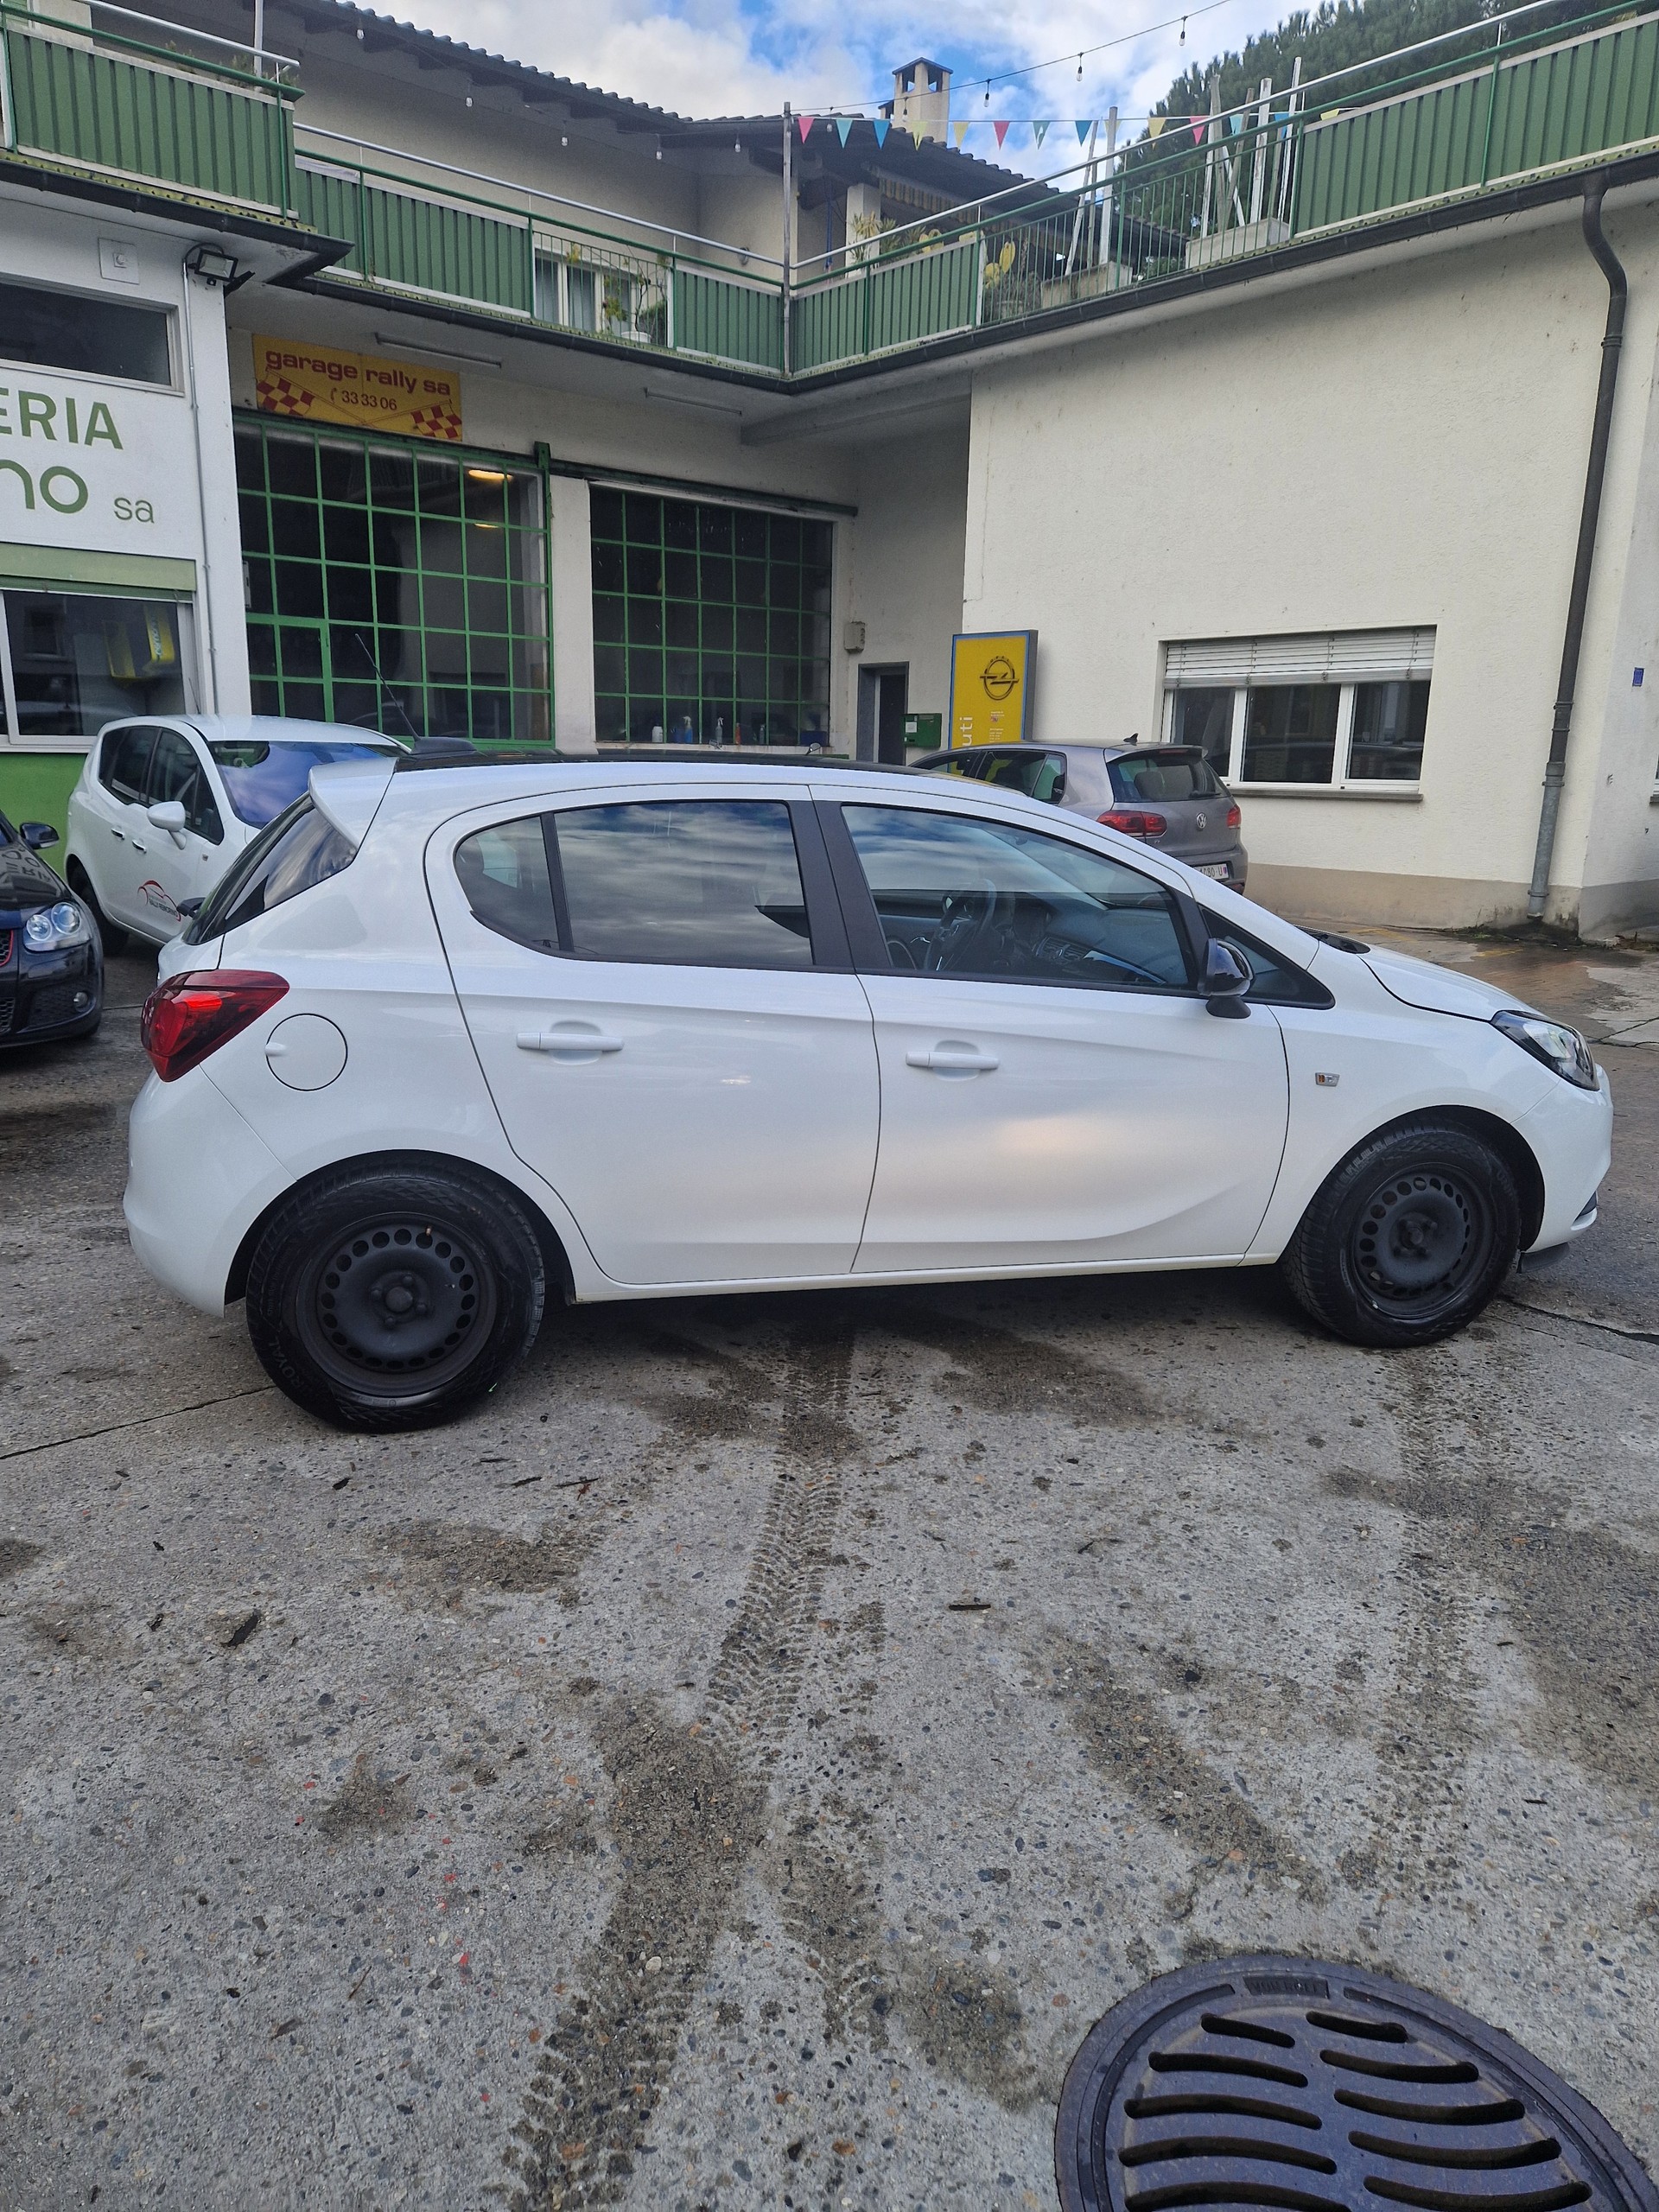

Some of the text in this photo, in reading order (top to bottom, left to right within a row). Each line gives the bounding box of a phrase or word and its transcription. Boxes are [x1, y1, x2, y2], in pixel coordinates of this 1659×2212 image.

[266, 350, 451, 396] garage rally sa
[114, 497, 155, 524] sa
